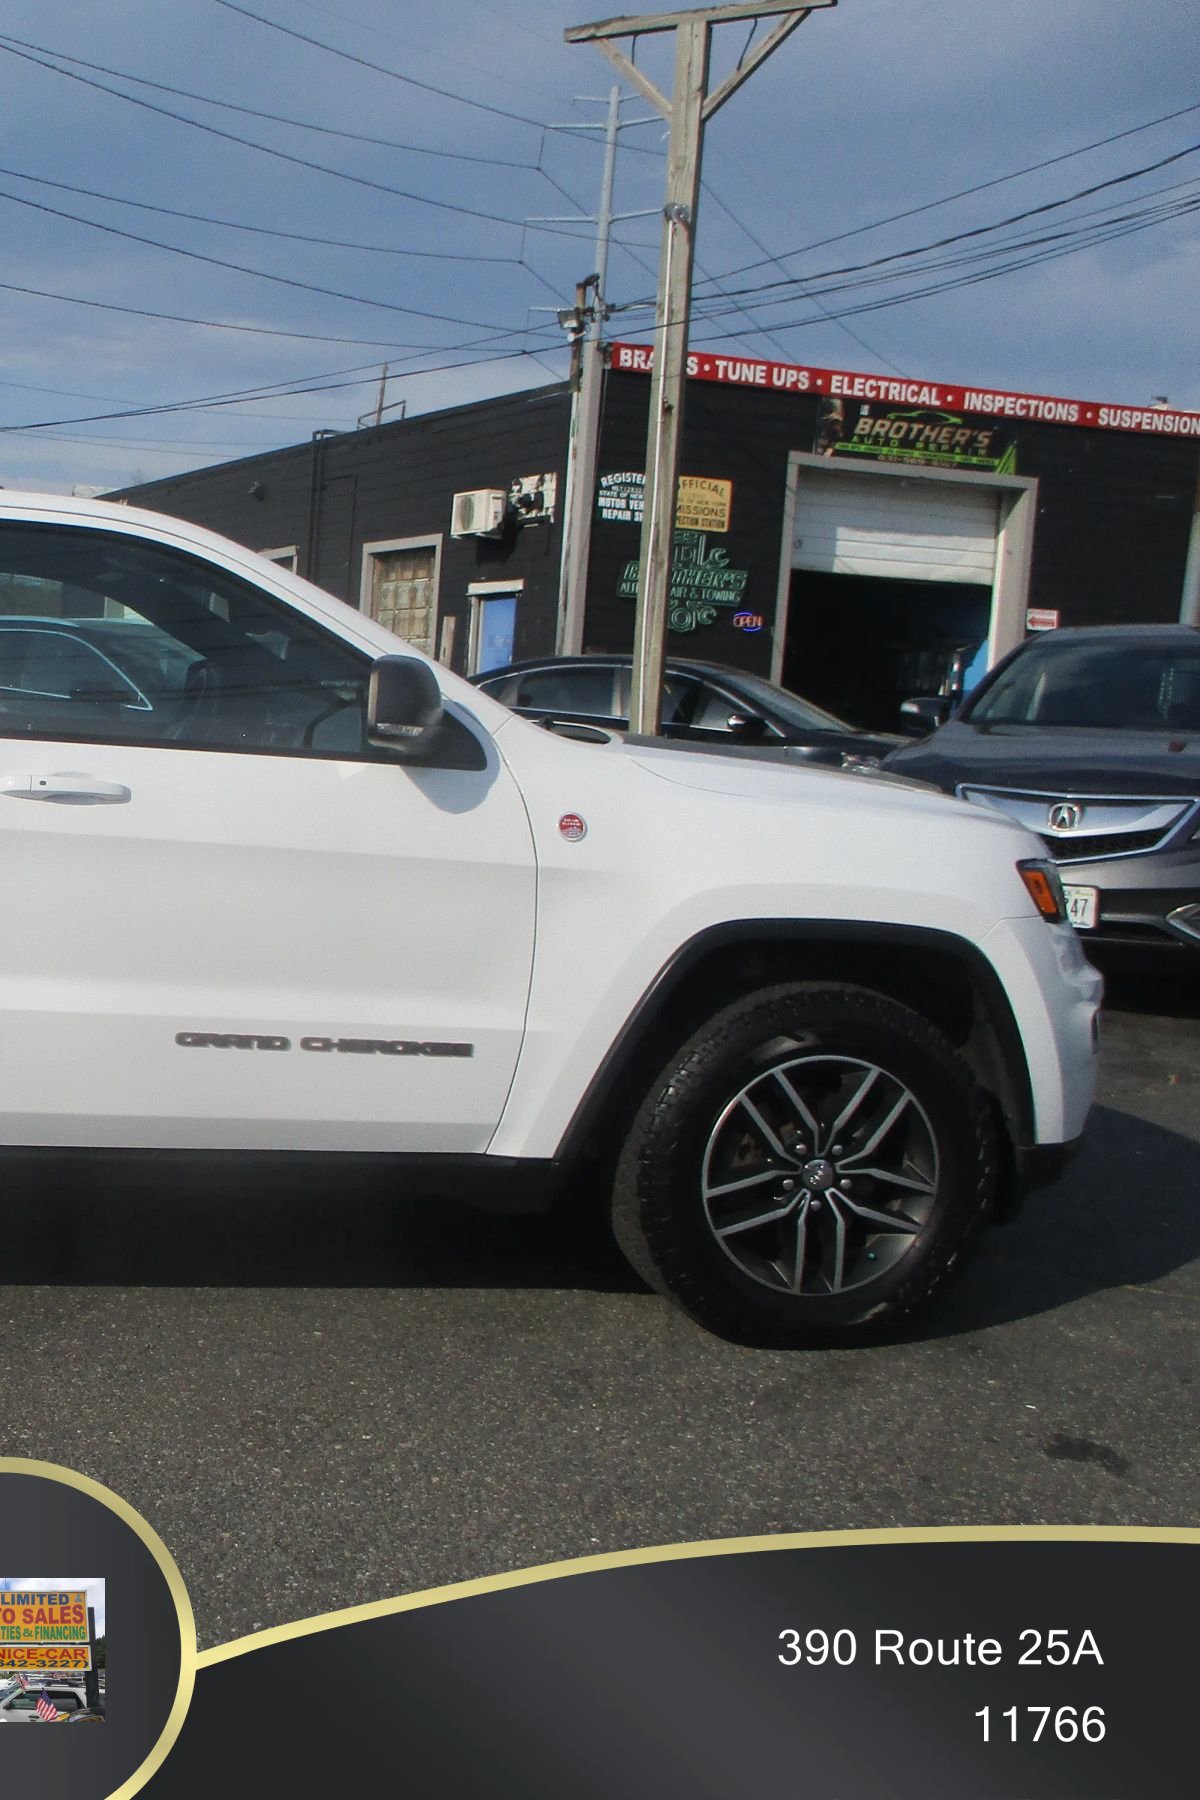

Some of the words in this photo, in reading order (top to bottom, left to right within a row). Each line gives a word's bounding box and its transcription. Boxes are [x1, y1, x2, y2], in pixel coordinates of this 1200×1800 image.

[715, 360, 767, 384] TUNE
[772, 366, 810, 389] UPS
[830, 374, 941, 407] ELECTRICAL
[963, 391, 1078, 423] INSPECTIONS
[854, 417, 993, 448] BROTHER'S
[851, 435, 900, 448] AUTO
[915, 442, 987, 457] REPAIR
[679, 479, 726, 497] FFICIAL
[598, 496, 626, 509] MOTOR
[602, 508, 631, 521] REPAIR
[701, 588, 741, 602] TOWING
[733, 615, 763, 628] OPEN
[175, 1031, 291, 1052] GRAND
[300, 1036, 475, 1058] CHEROKEE
